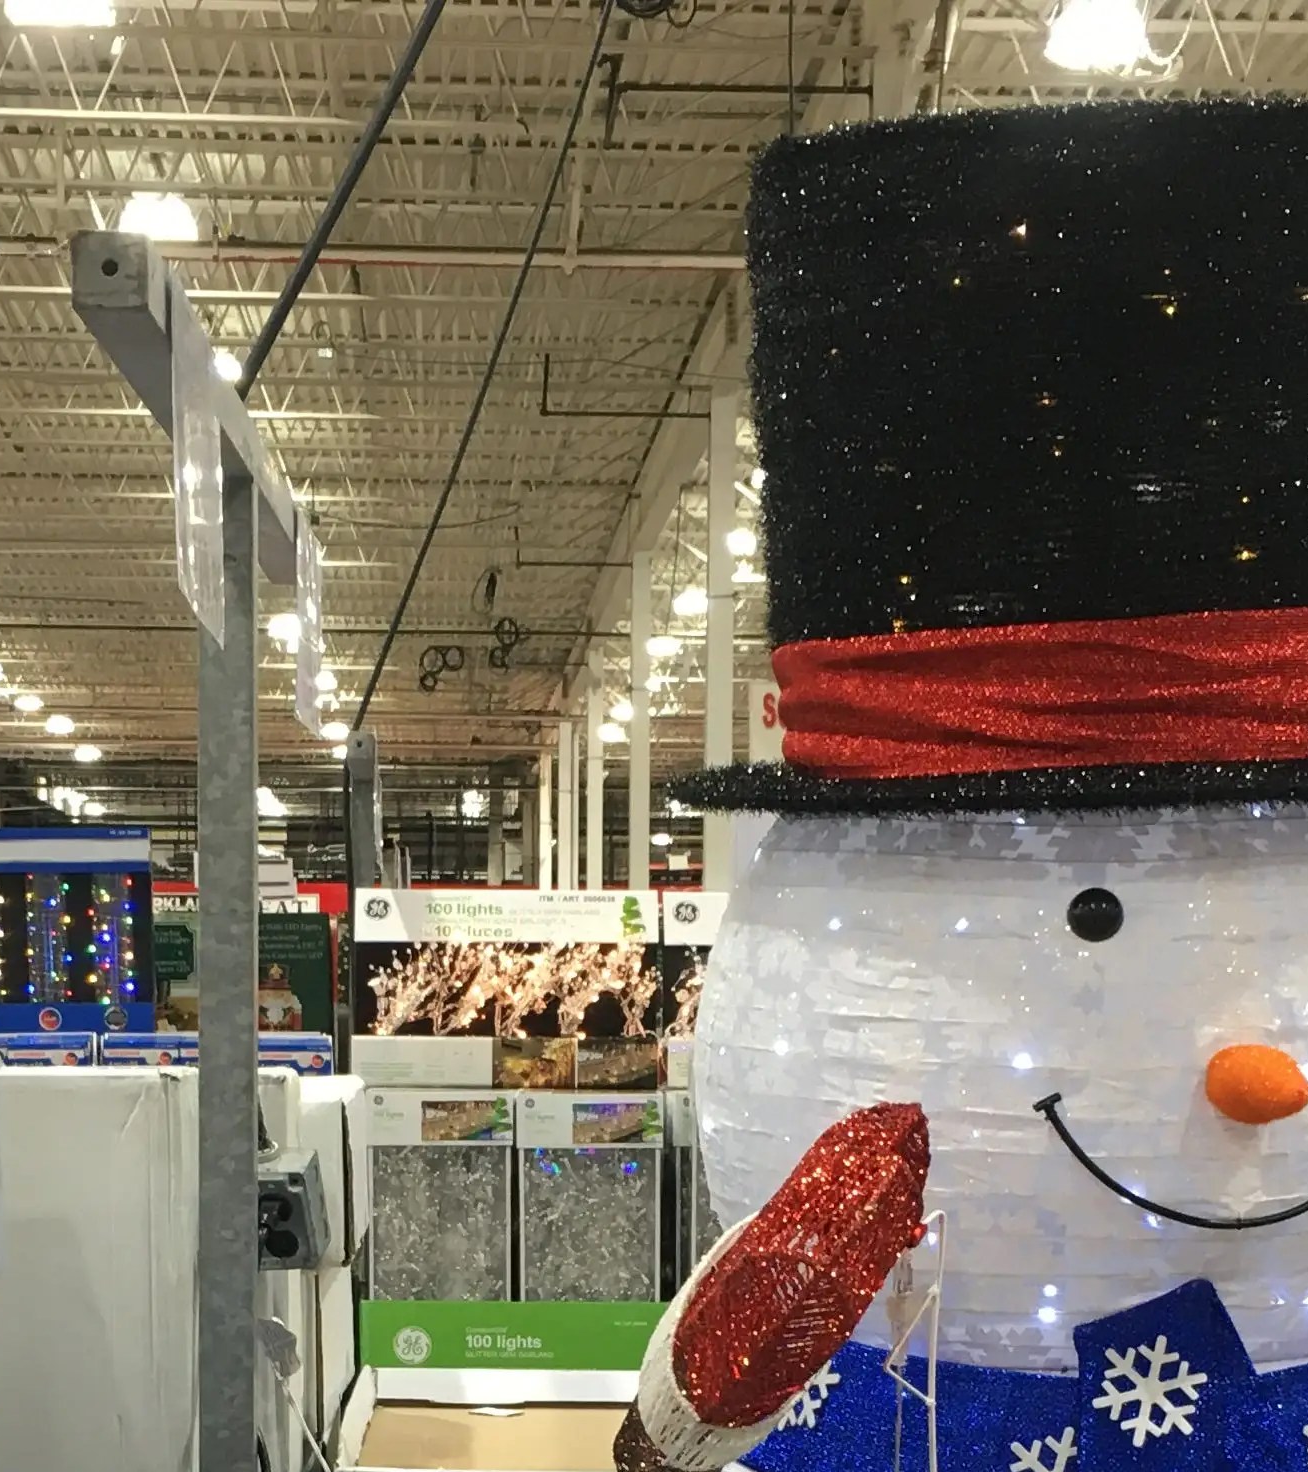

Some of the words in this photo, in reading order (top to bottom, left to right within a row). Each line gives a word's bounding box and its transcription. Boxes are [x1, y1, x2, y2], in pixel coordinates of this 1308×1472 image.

[425, 903, 453, 915] 100
[457, 903, 503, 917] lights
[465, 1336, 491, 1349] 100
[496, 1335, 542, 1352] lights
